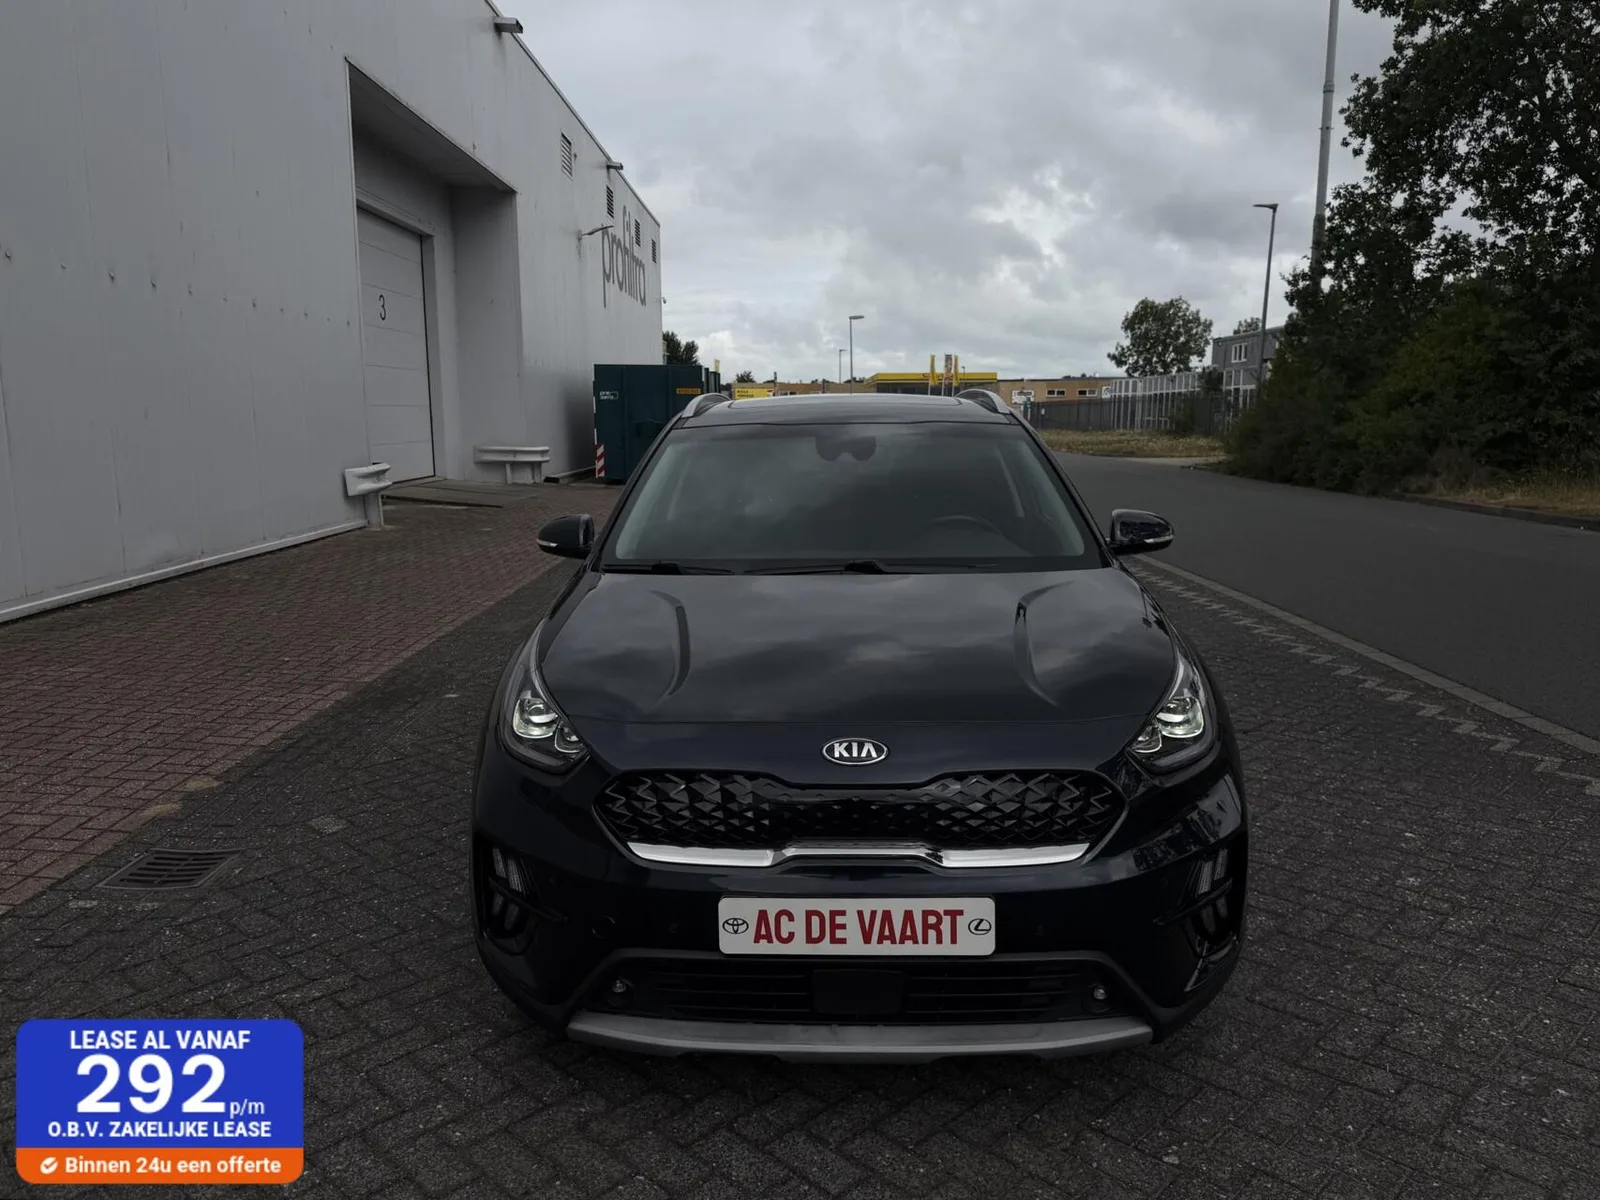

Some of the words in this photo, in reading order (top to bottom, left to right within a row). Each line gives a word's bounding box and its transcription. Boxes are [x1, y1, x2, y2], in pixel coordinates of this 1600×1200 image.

[601, 204, 647, 309] profiltra
[378, 294, 387, 321] 3
[833, 742, 878, 758] KIA
[753, 909, 795, 944] AC
[804, 909, 847, 944] DE
[856, 909, 964, 945] VAART
